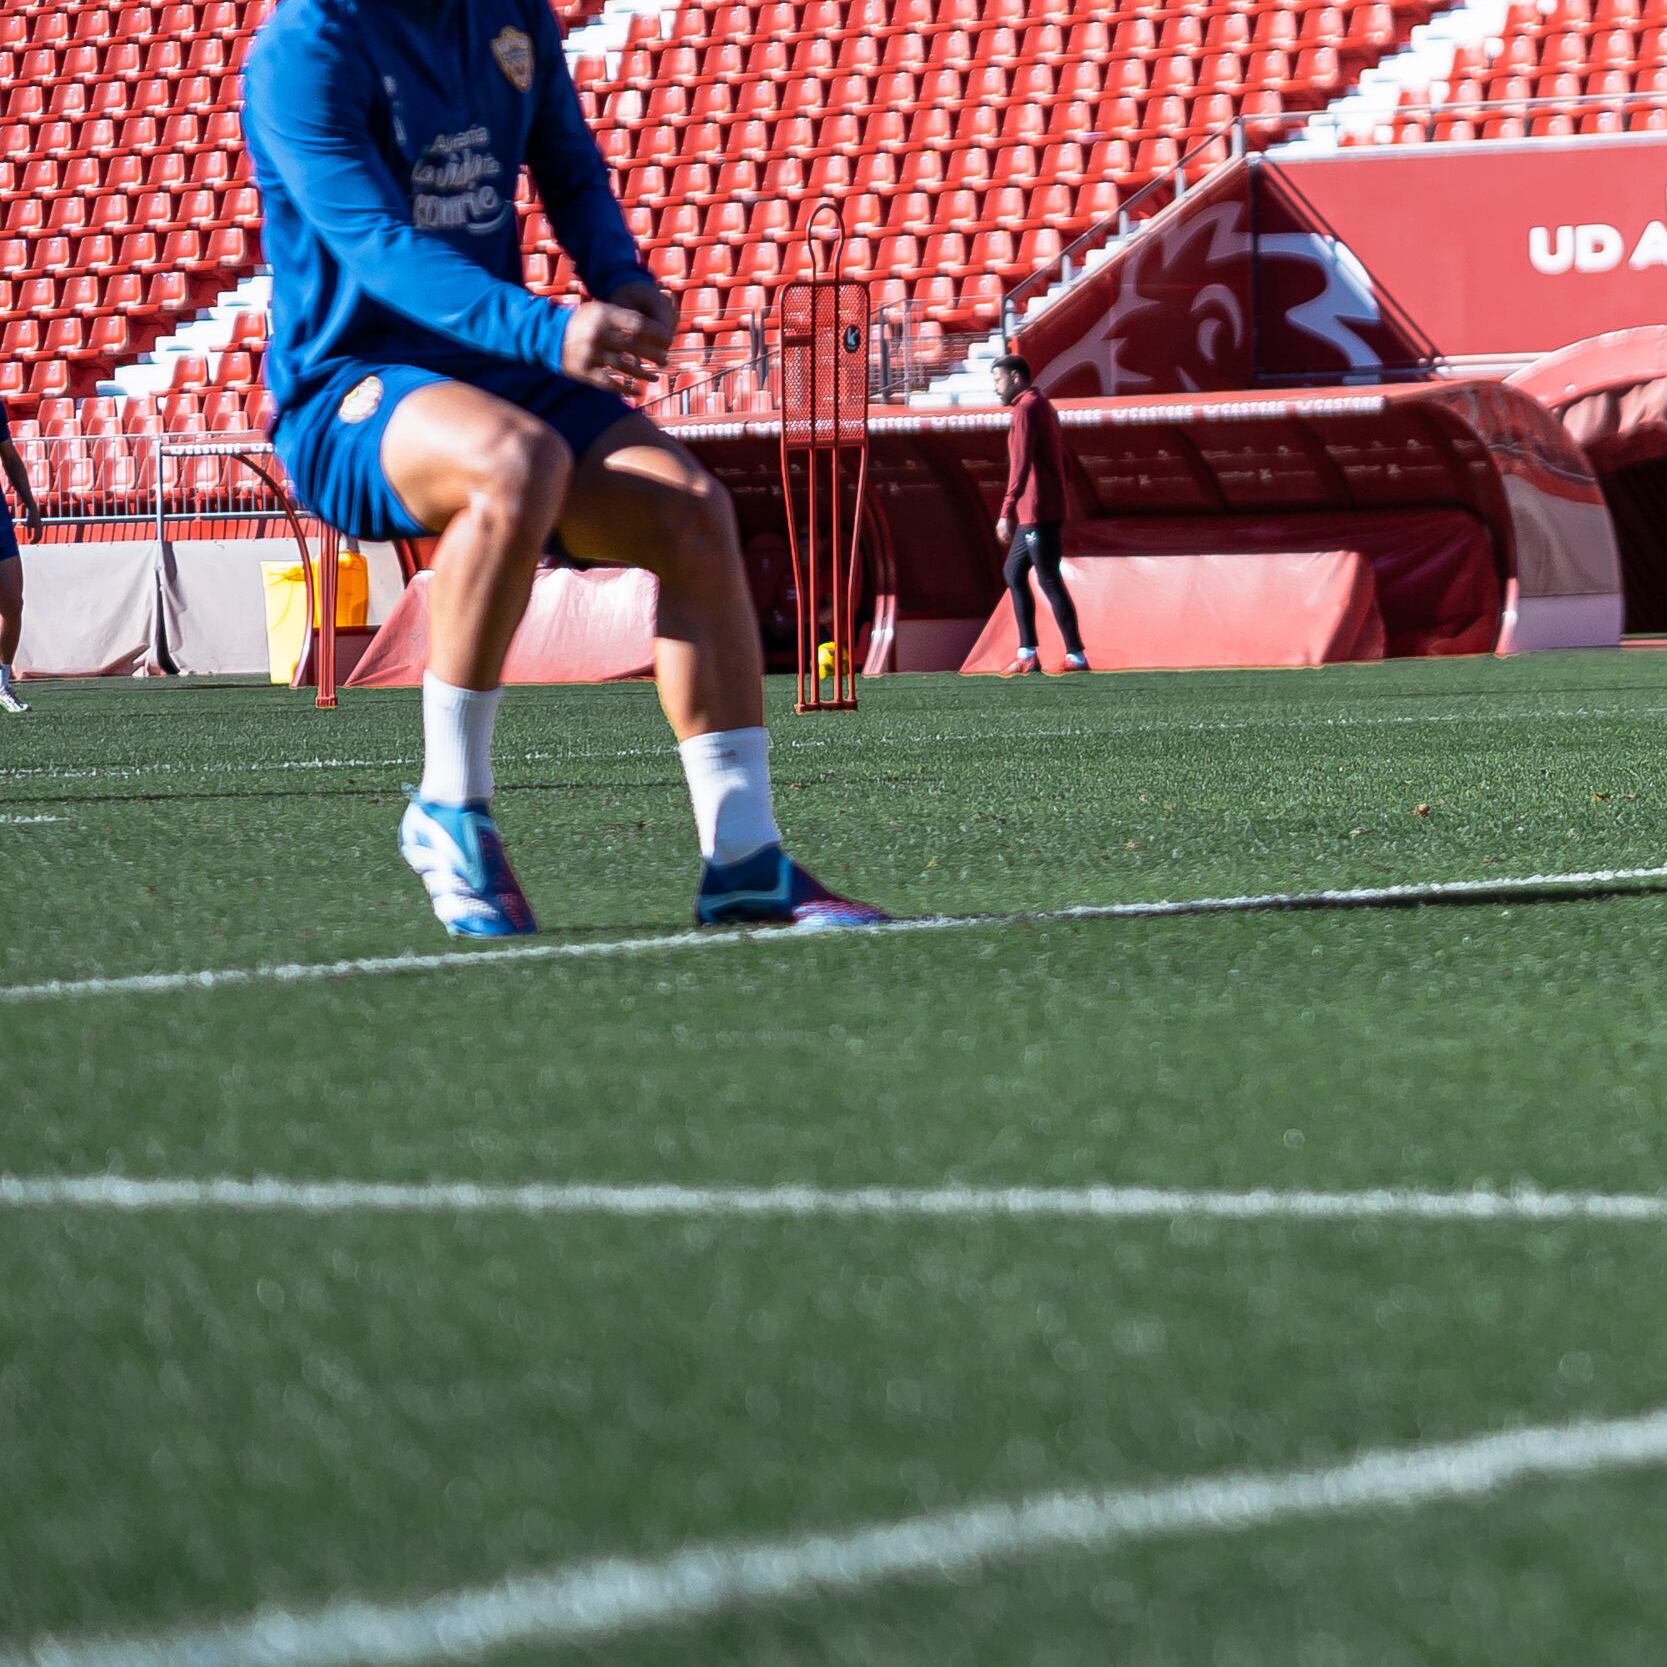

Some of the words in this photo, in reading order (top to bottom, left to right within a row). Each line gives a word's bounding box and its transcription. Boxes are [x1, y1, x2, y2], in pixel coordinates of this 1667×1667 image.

[1528, 224, 1624, 274] UD
[1129, 404, 1194, 422] CASTORE
[1221, 400, 1287, 418] CASTORE
[1313, 396, 1385, 414] CASTORE
